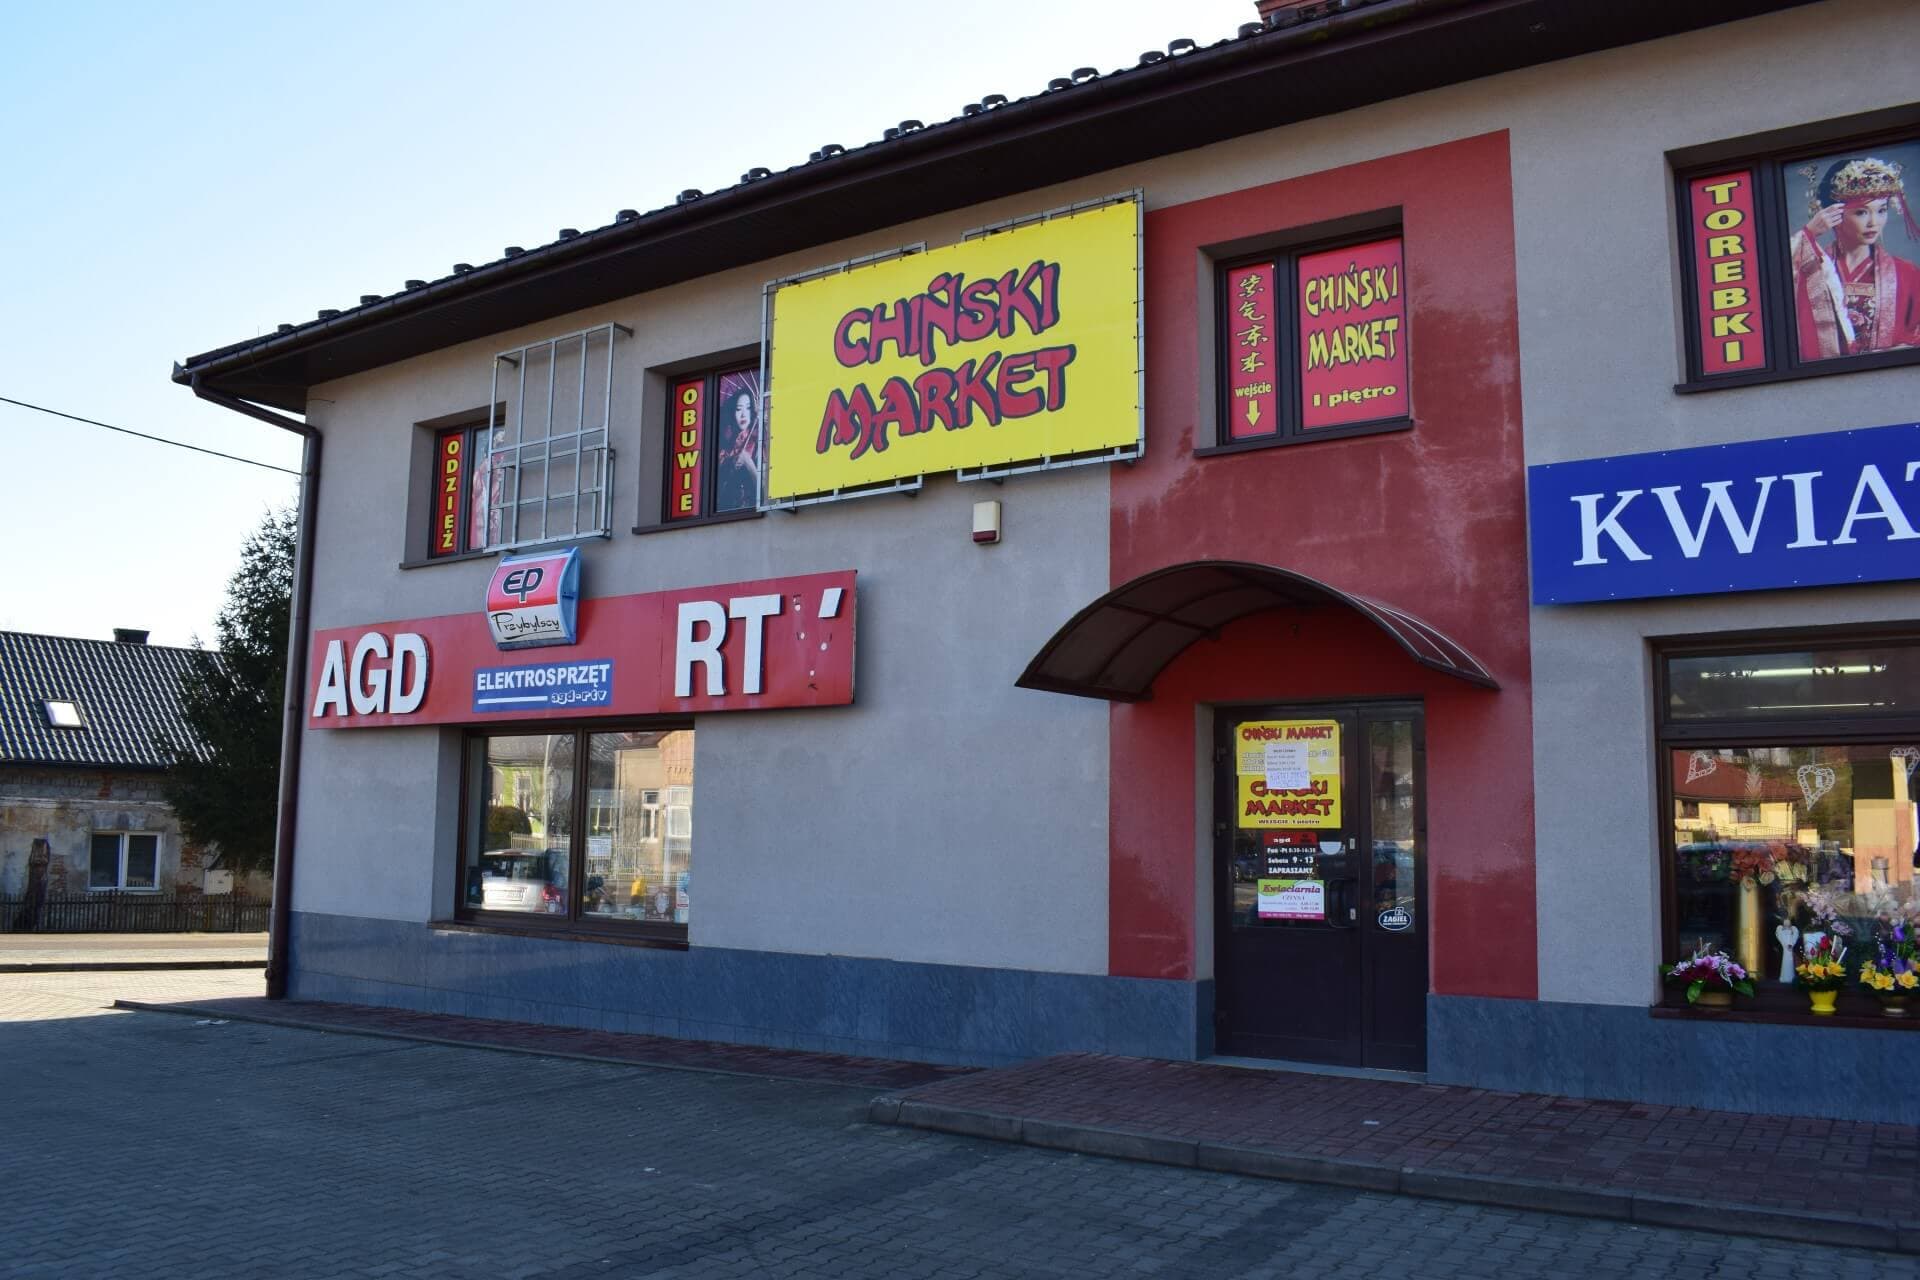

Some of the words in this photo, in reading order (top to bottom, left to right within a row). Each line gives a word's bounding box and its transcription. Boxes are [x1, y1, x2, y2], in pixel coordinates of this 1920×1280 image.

[1305, 261, 1398, 318] CHIŃSKI
[1702, 179, 1753, 363] TOREBKI
[834, 259, 1060, 368] CHIŃSKI
[1307, 316, 1399, 372] MARKET
[815, 343, 1077, 460] MARKET
[1235, 381, 1272, 398] wejście
[1328, 384, 1397, 408] piętro
[677, 387, 700, 513] OBUWIE
[440, 439, 461, 549] ODZIEŻ
[313, 631, 430, 719] AGD
[477, 663, 611, 691] ELEKTROSPRZĘT
[1286, 726, 1334, 741] MARKET
[1245, 798, 1335, 817] MARKET
[1264, 884, 1321, 893] Kwiaciarnia
